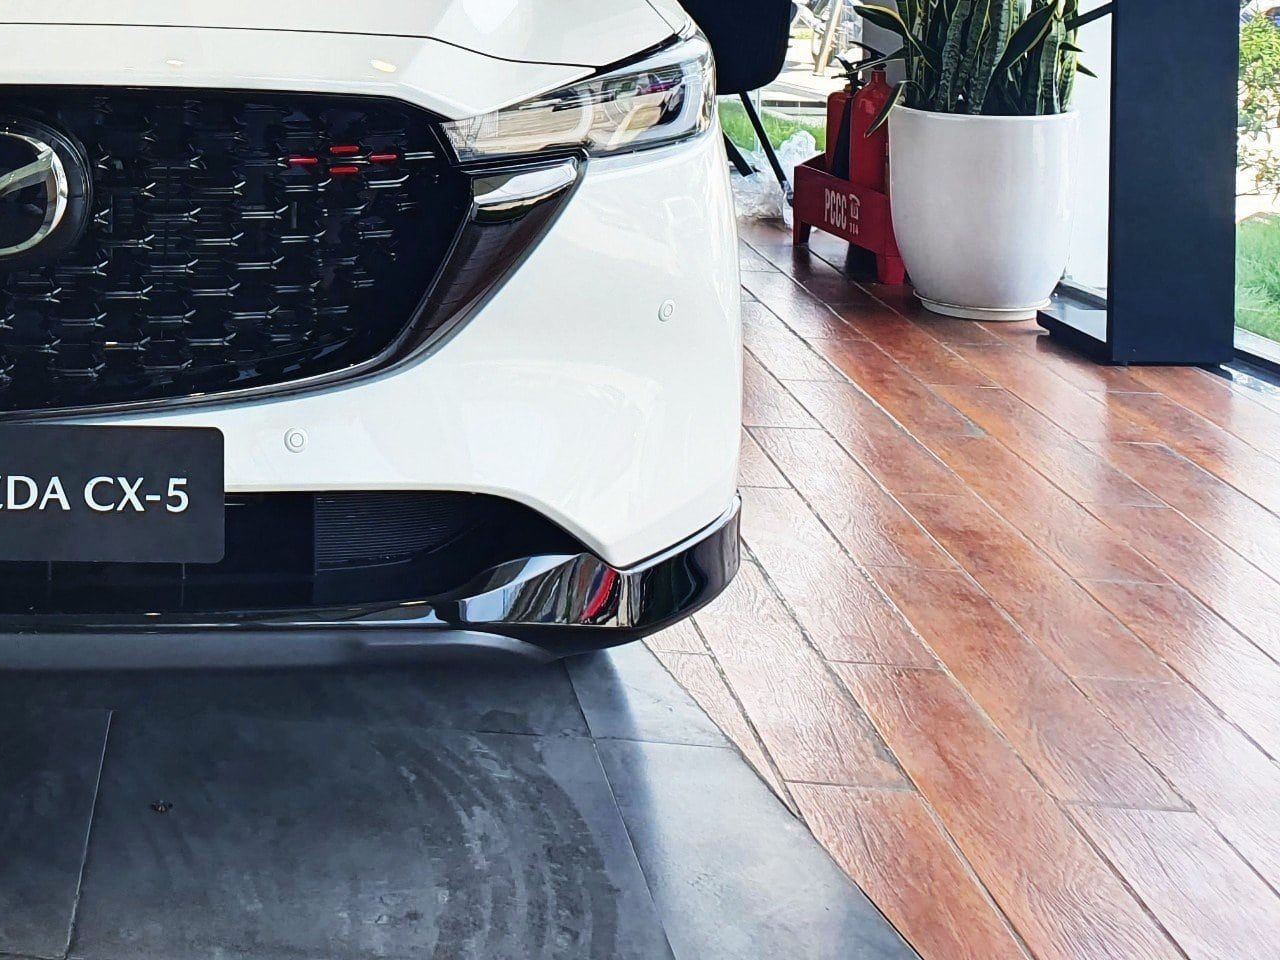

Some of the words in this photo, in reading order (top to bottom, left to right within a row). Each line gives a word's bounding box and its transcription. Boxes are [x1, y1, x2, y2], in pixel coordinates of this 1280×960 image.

[824, 187, 847, 230] PCCC
[849, 222, 859, 235] 114
[83, 475, 190, 513] CX-5
